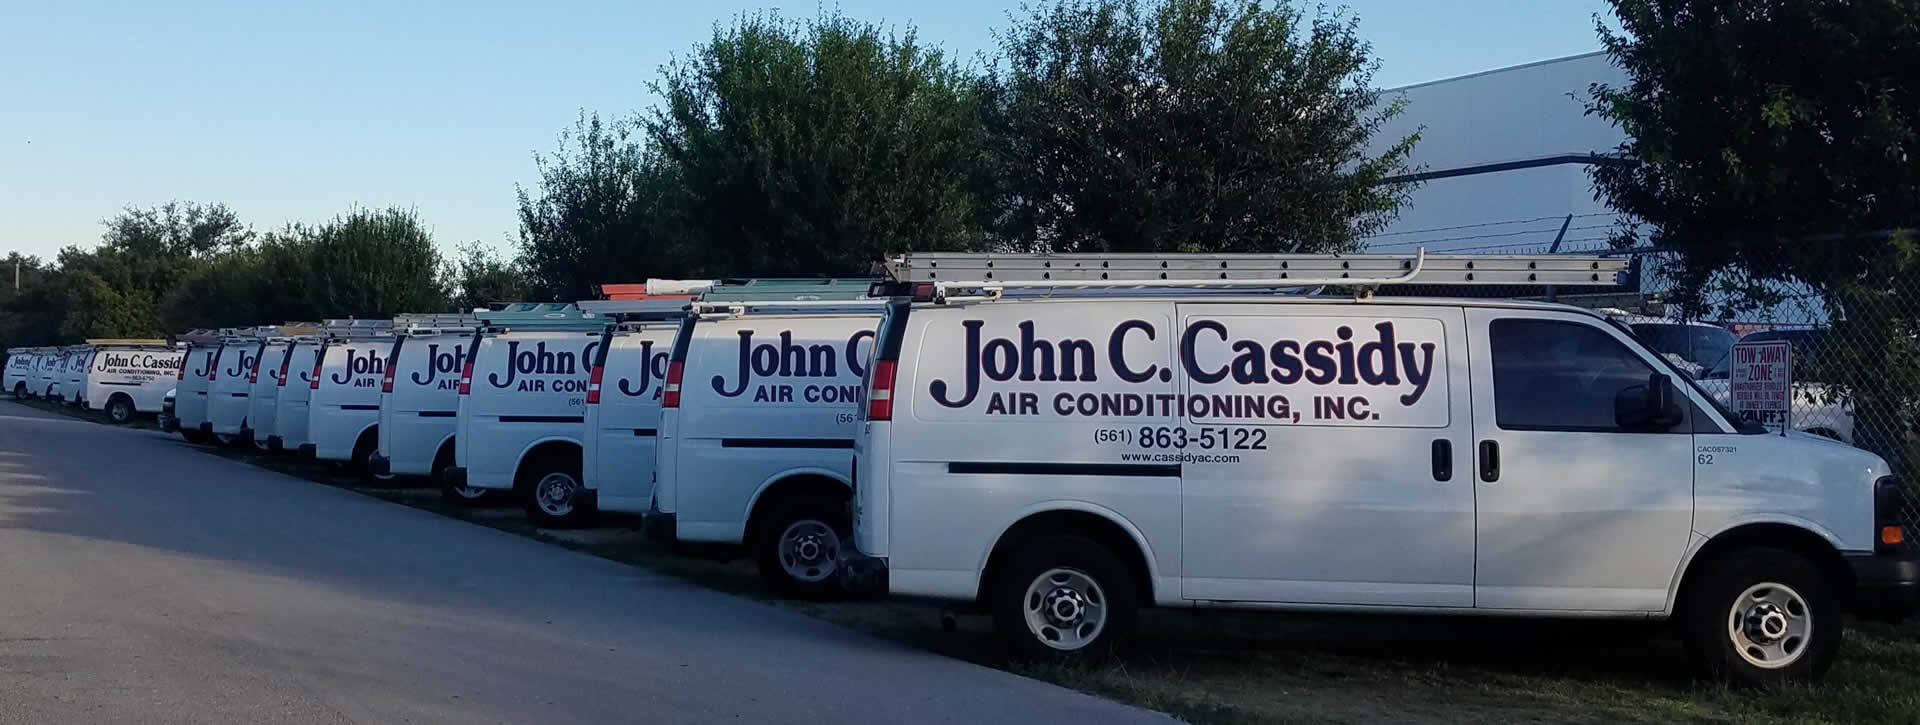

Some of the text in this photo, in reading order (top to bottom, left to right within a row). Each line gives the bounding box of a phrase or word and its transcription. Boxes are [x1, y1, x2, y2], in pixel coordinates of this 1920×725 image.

[97, 353, 128, 371] John
[130, 354, 141, 368] C.
[488, 341, 576, 388] John
[711, 330, 837, 397] John
[929, 319, 1435, 408] John C. Cassidy
[1748, 364, 1773, 381] ZONE
[354, 378, 375, 388] AIR
[517, 379, 545, 392] AIR
[754, 384, 793, 403] AIR
[985, 392, 1380, 423] AIR CONDITIONING, INC.
[1094, 427, 1267, 450] (561) 863-5122
[1121, 453, 1240, 464] www.cassidyac.com
[1698, 454, 1714, 464] 62
